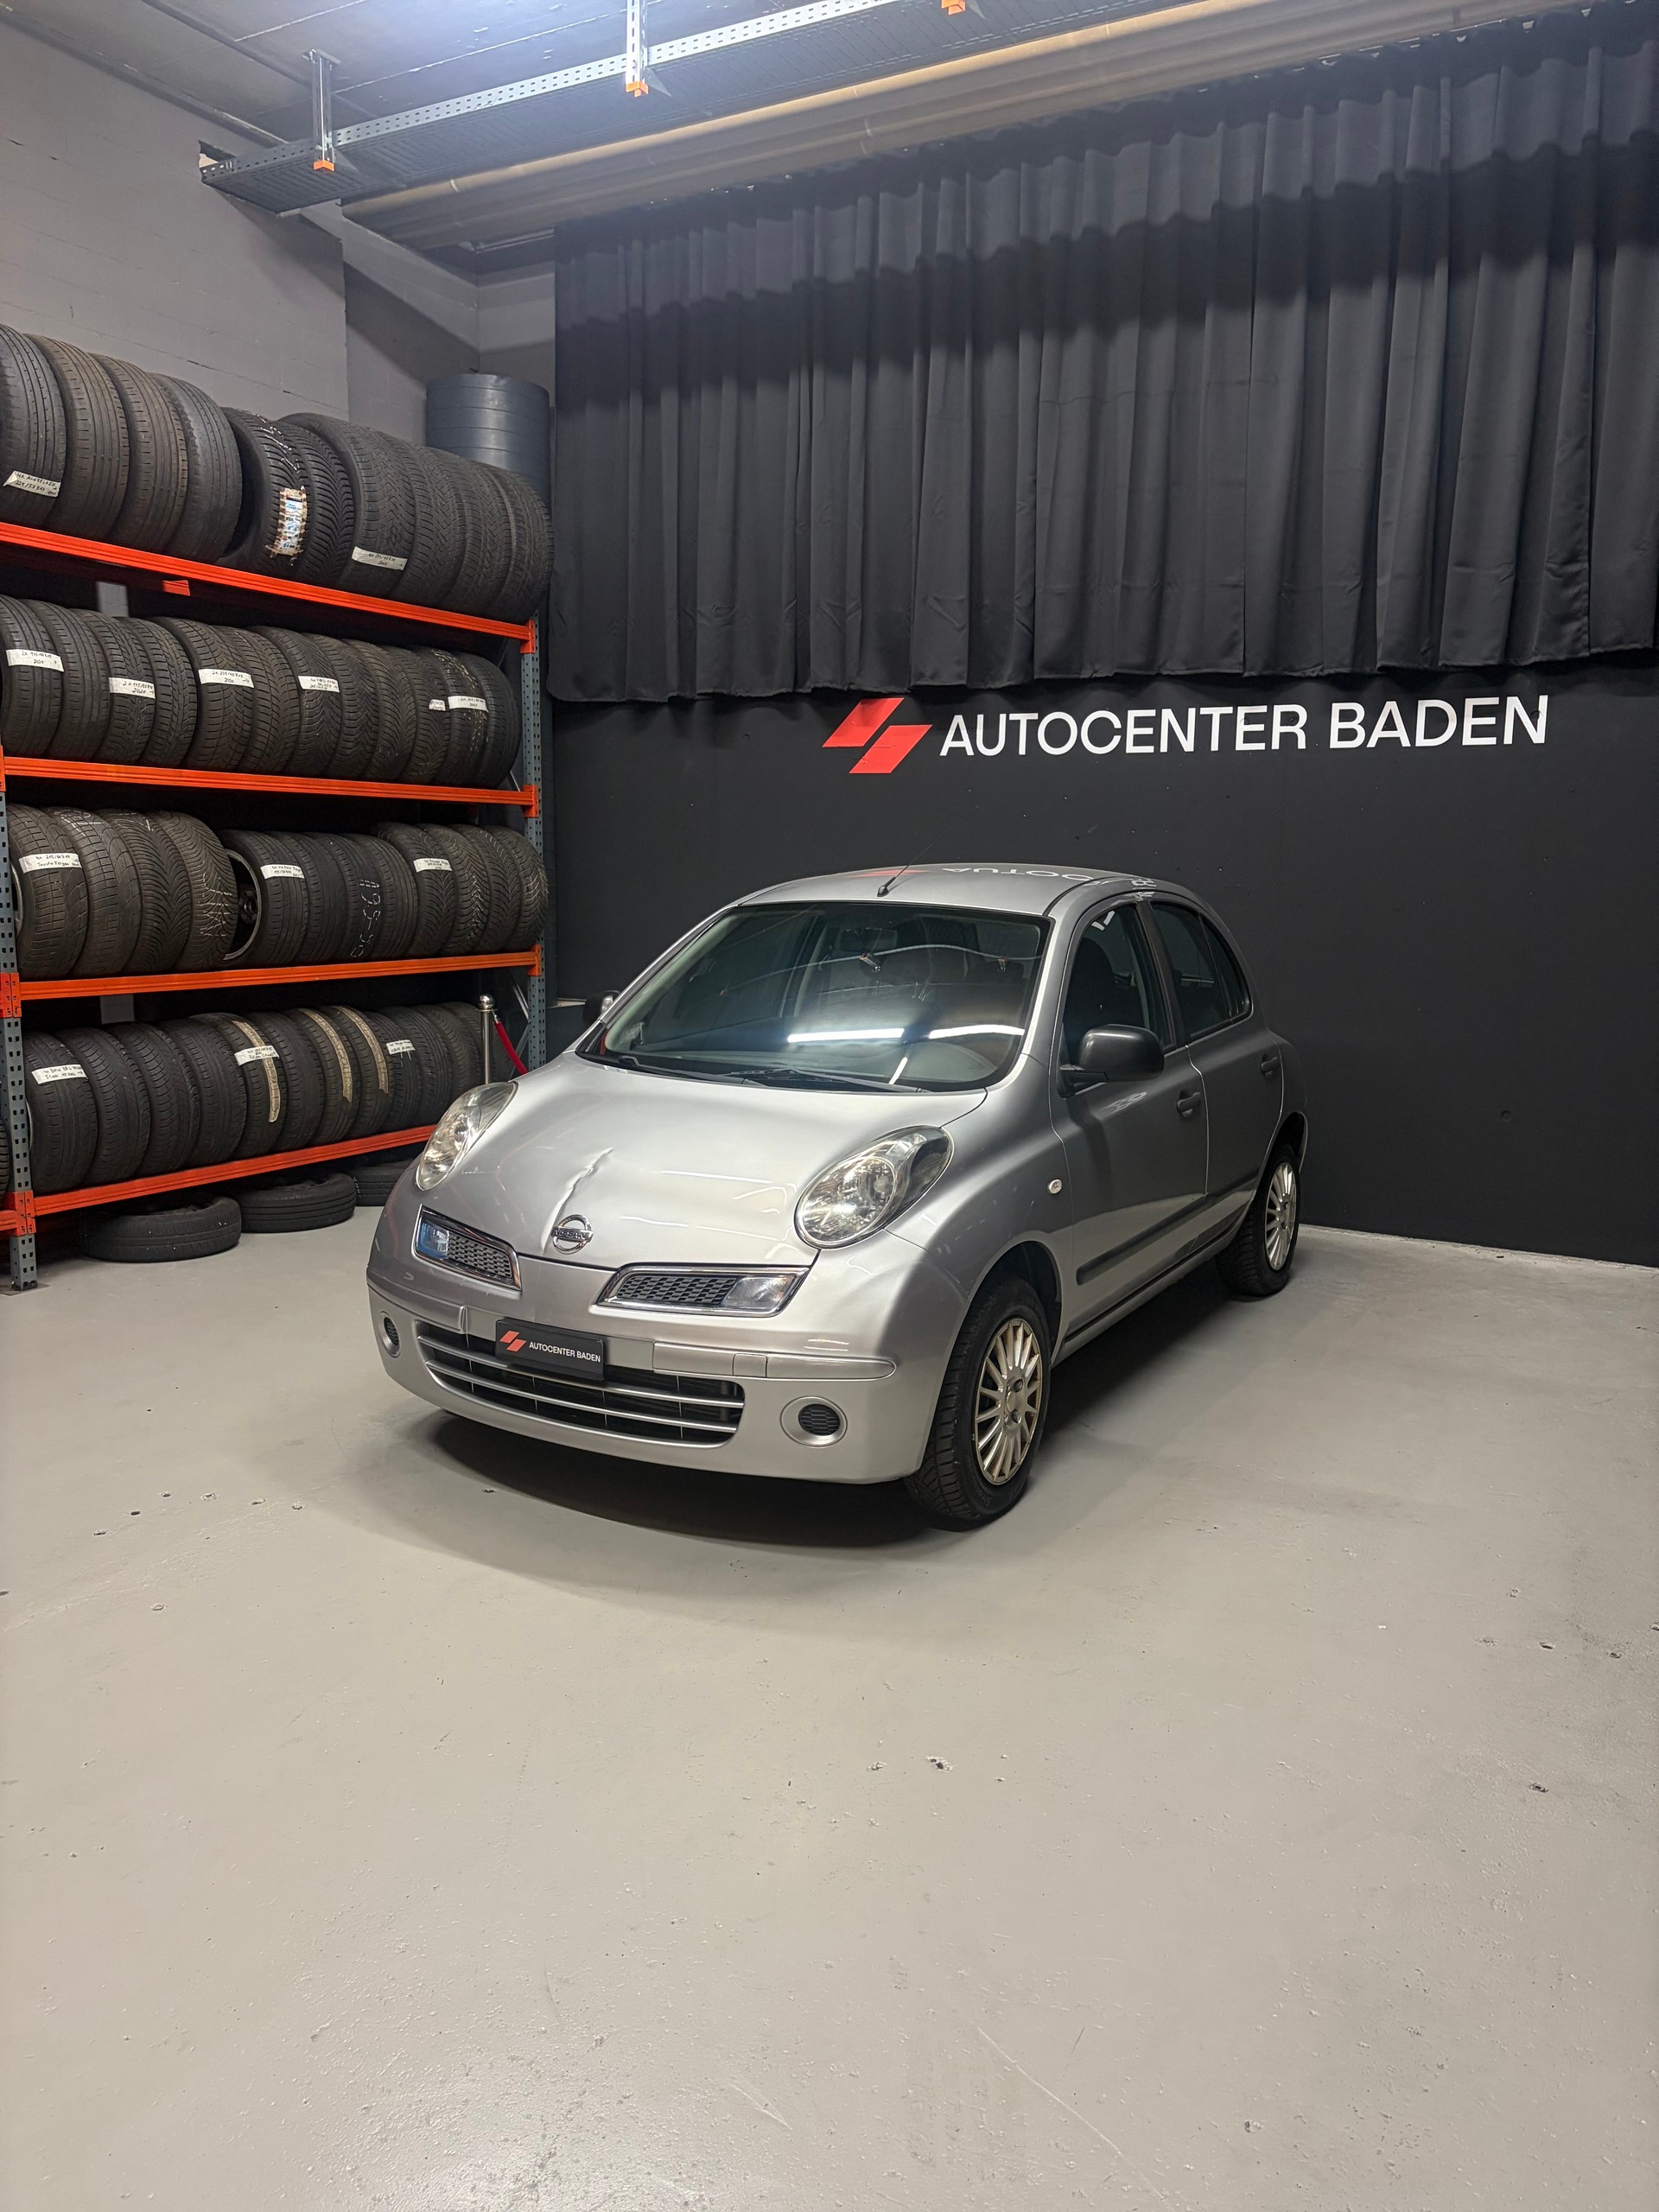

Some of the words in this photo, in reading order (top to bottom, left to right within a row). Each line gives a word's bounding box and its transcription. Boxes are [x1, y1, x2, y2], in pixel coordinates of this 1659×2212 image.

[939, 704, 1307, 756] AUTOCENTER
[1329, 695, 1548, 749] BADEN
[529, 1342, 575, 1357] AUTOCENTER
[576, 1351, 601, 1363] BADEN
